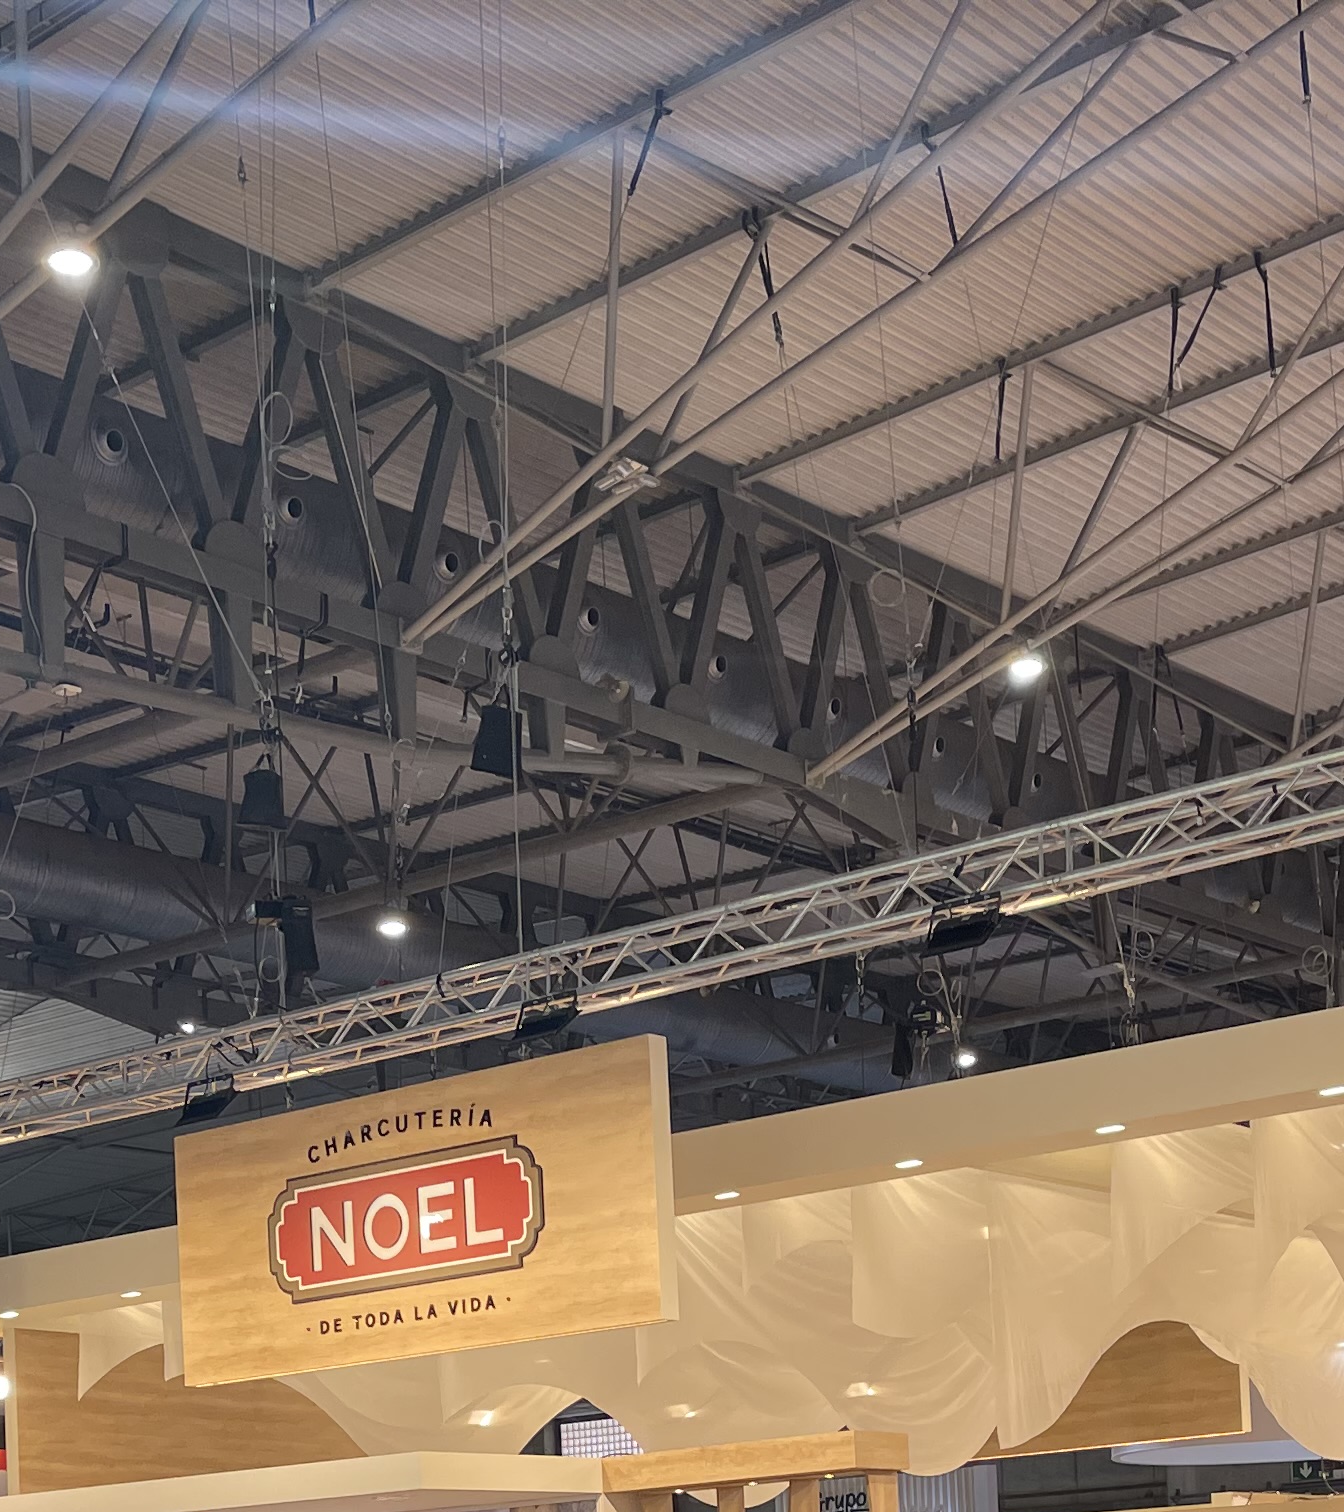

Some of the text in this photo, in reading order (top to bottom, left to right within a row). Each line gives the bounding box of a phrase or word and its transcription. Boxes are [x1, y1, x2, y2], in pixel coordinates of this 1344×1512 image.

[307, 1103, 493, 1164] CHARCUTERÍA
[309, 1177, 504, 1273] NOEL
[319, 1294, 497, 1335] DE TODA LA VIDA
